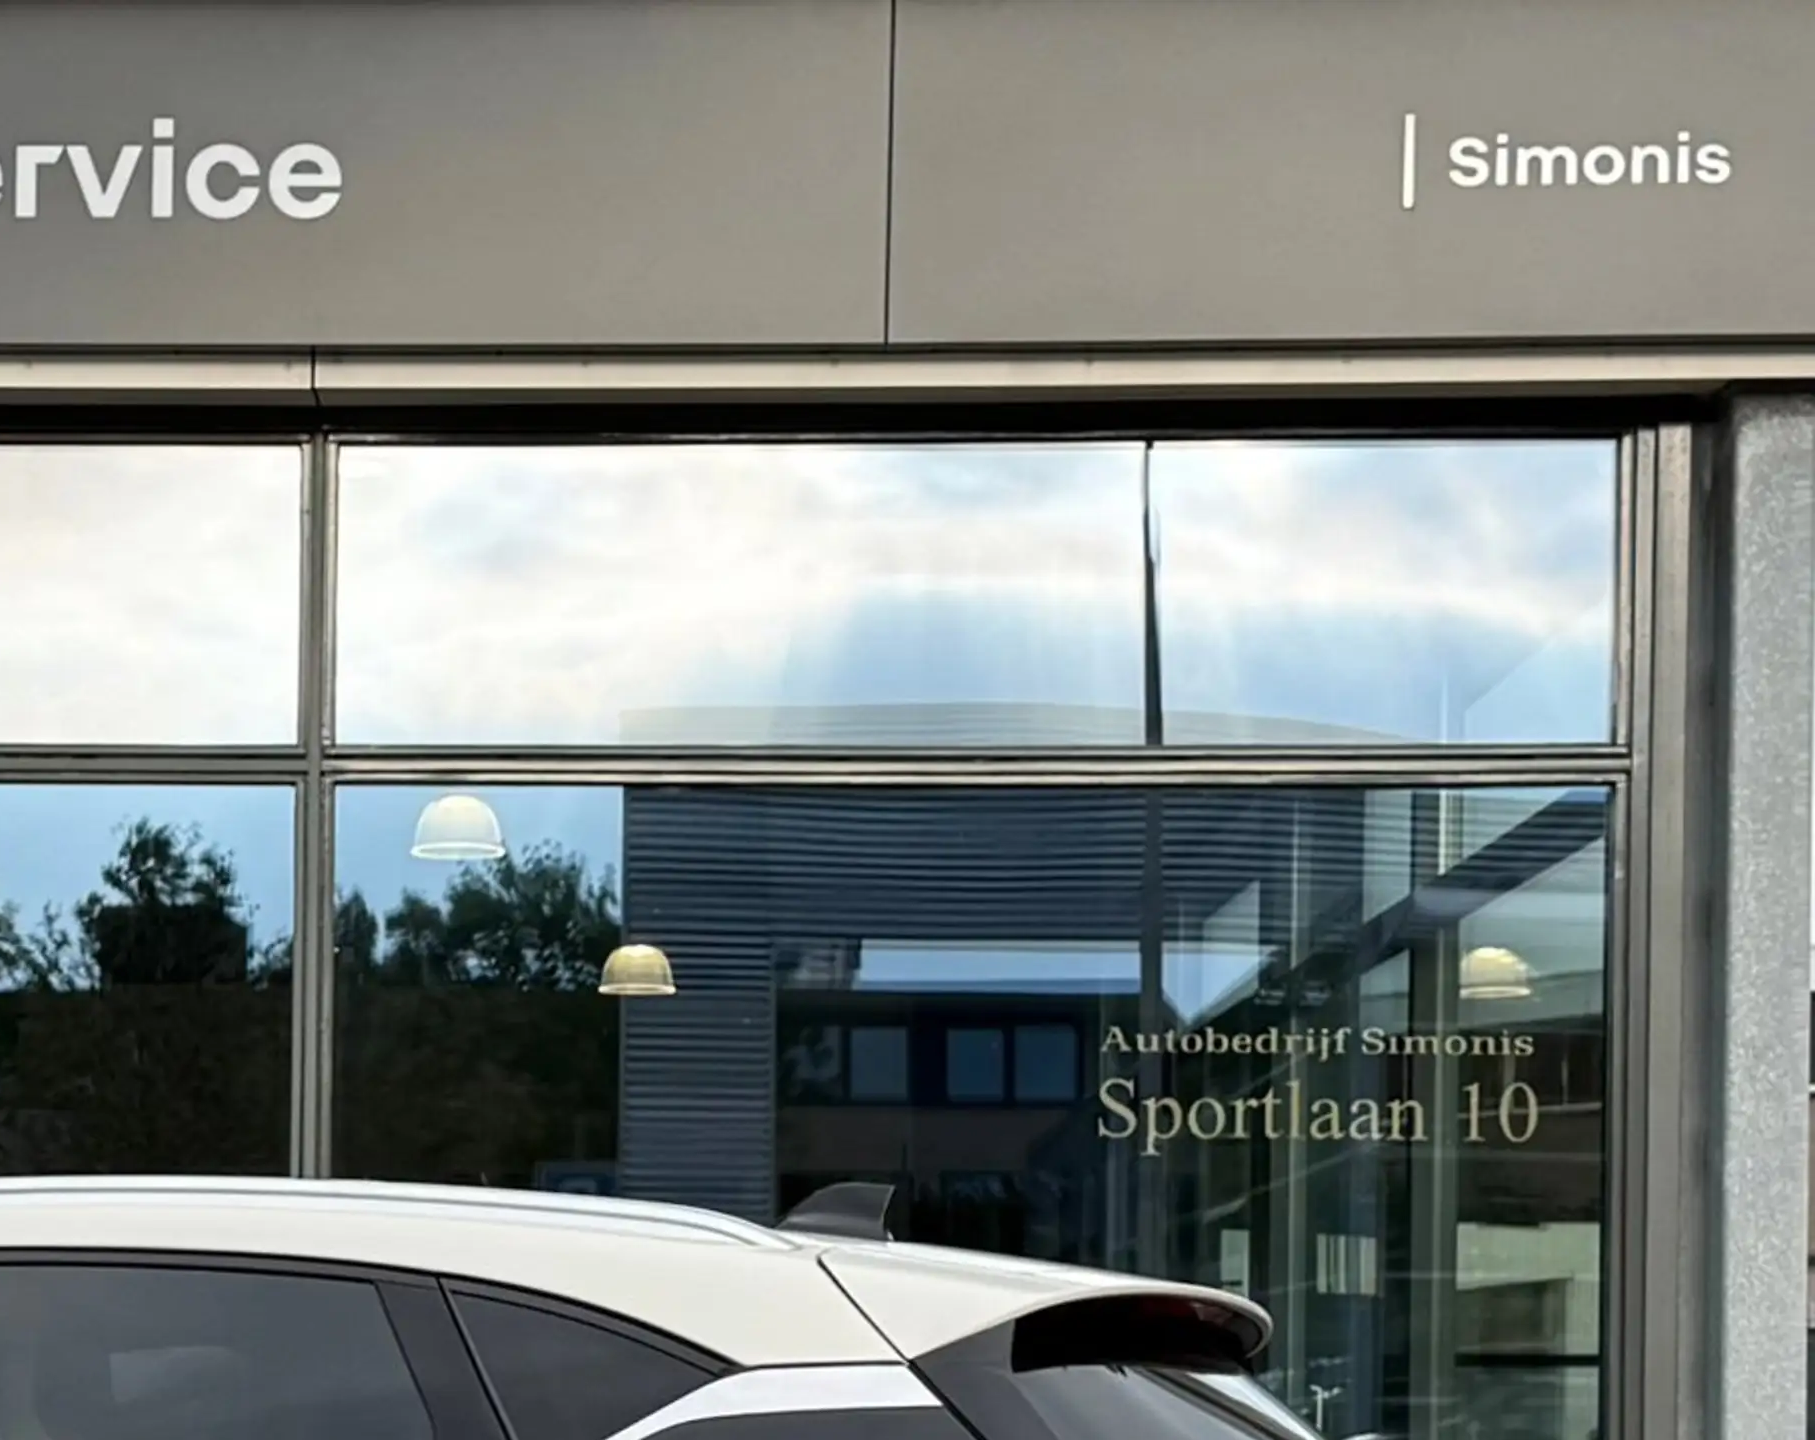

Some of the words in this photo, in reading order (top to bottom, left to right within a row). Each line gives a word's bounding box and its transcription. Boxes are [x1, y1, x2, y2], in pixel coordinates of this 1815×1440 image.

[1448, 130, 1732, 188] Simonis
[1101, 1025, 1352, 1063] Autobedrijf
[1360, 1026, 1536, 1057] Simonis
[1097, 1077, 1429, 1157] Sportlaan
[1462, 1081, 1539, 1143] 10
